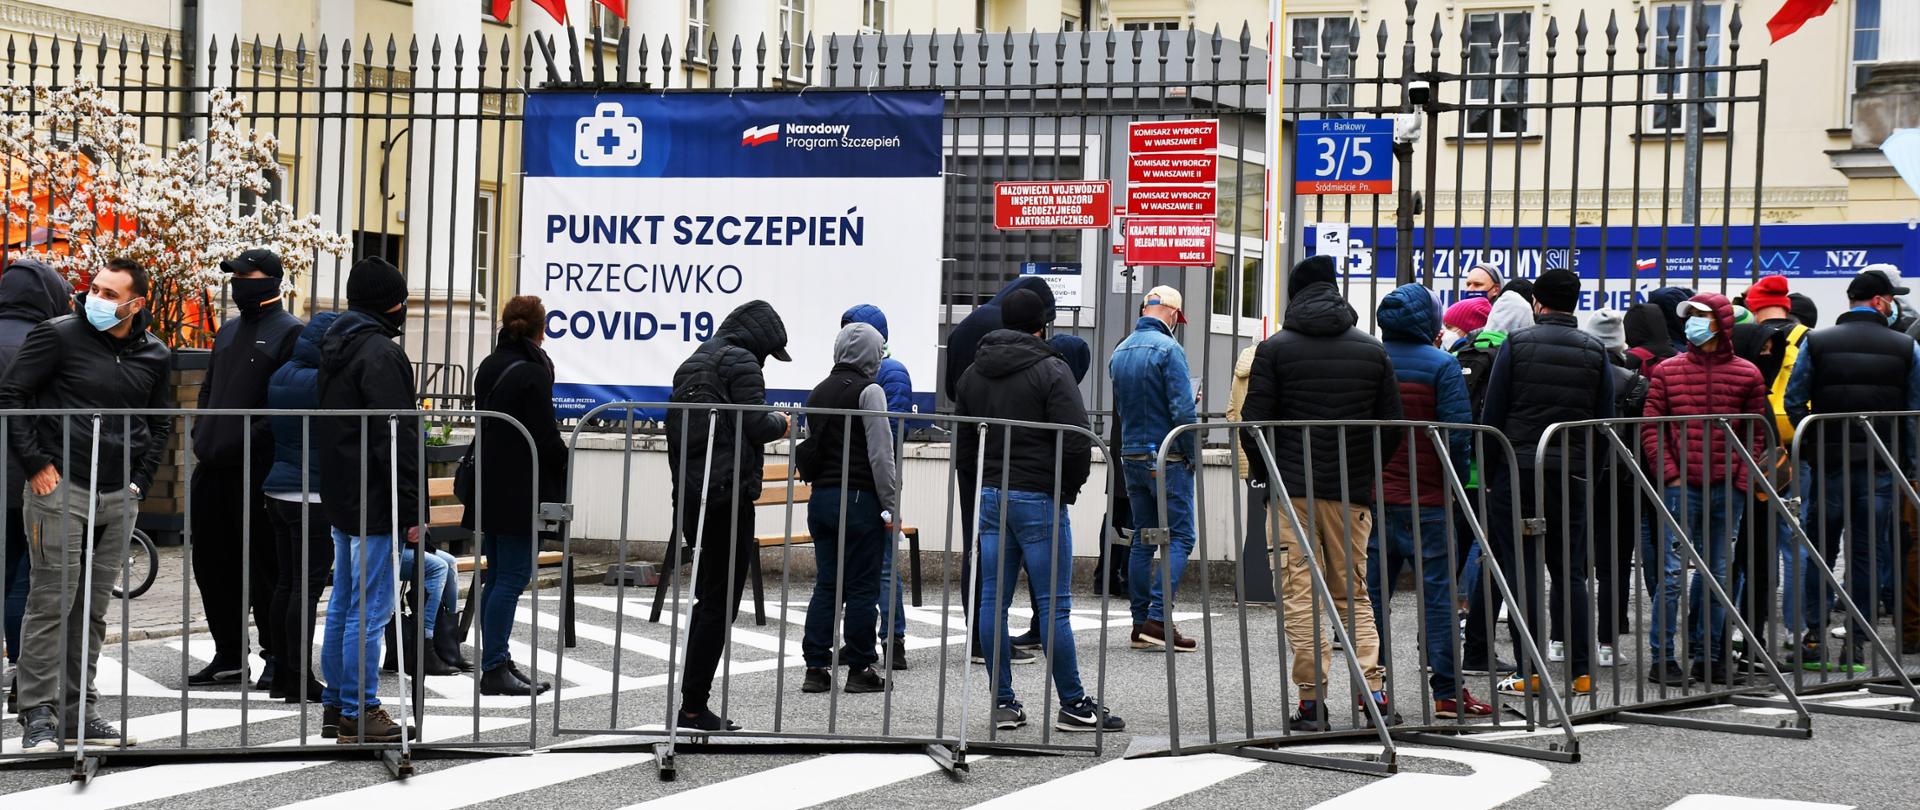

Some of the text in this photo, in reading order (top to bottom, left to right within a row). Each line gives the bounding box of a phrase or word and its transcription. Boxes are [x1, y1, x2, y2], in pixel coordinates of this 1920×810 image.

[786, 123, 850, 136] Narodowy
[1134, 127, 1213, 136] KOMISARZ WYBORCZY
[1322, 122, 1366, 132] Pl. Bankowy
[786, 136, 900, 150] Program Szczepień
[1154, 138, 1197, 146] WARSZAWIE
[1133, 159, 1211, 167] KOMISARZ WYBORCZY
[1315, 136, 1373, 180] 3/5
[1000, 182, 1105, 196] MAZOWIECKI WOJEWÓDZKI
[1315, 182, 1371, 192] Śródmieście Pn.
[1011, 194, 1093, 206] INSPEKTOR NADZORU
[1022, 205, 1082, 216] GEODEZYJNEGO
[1010, 215, 1094, 225] I KARTOGRAFICZNEGO
[546, 206, 865, 246] PUNKT SZCZEPIEŃ
[1129, 225, 1211, 236] KRAJOWE BIURO WYBORCZE
[1134, 237, 1205, 248] DELEGATURA W WARSZAWIE
[1179, 251, 1201, 260] WEJŚCIE
[1826, 250, 1868, 268] NFZ
[545, 262, 743, 294] PRZECIWKO
[545, 309, 714, 342] COVID-19
